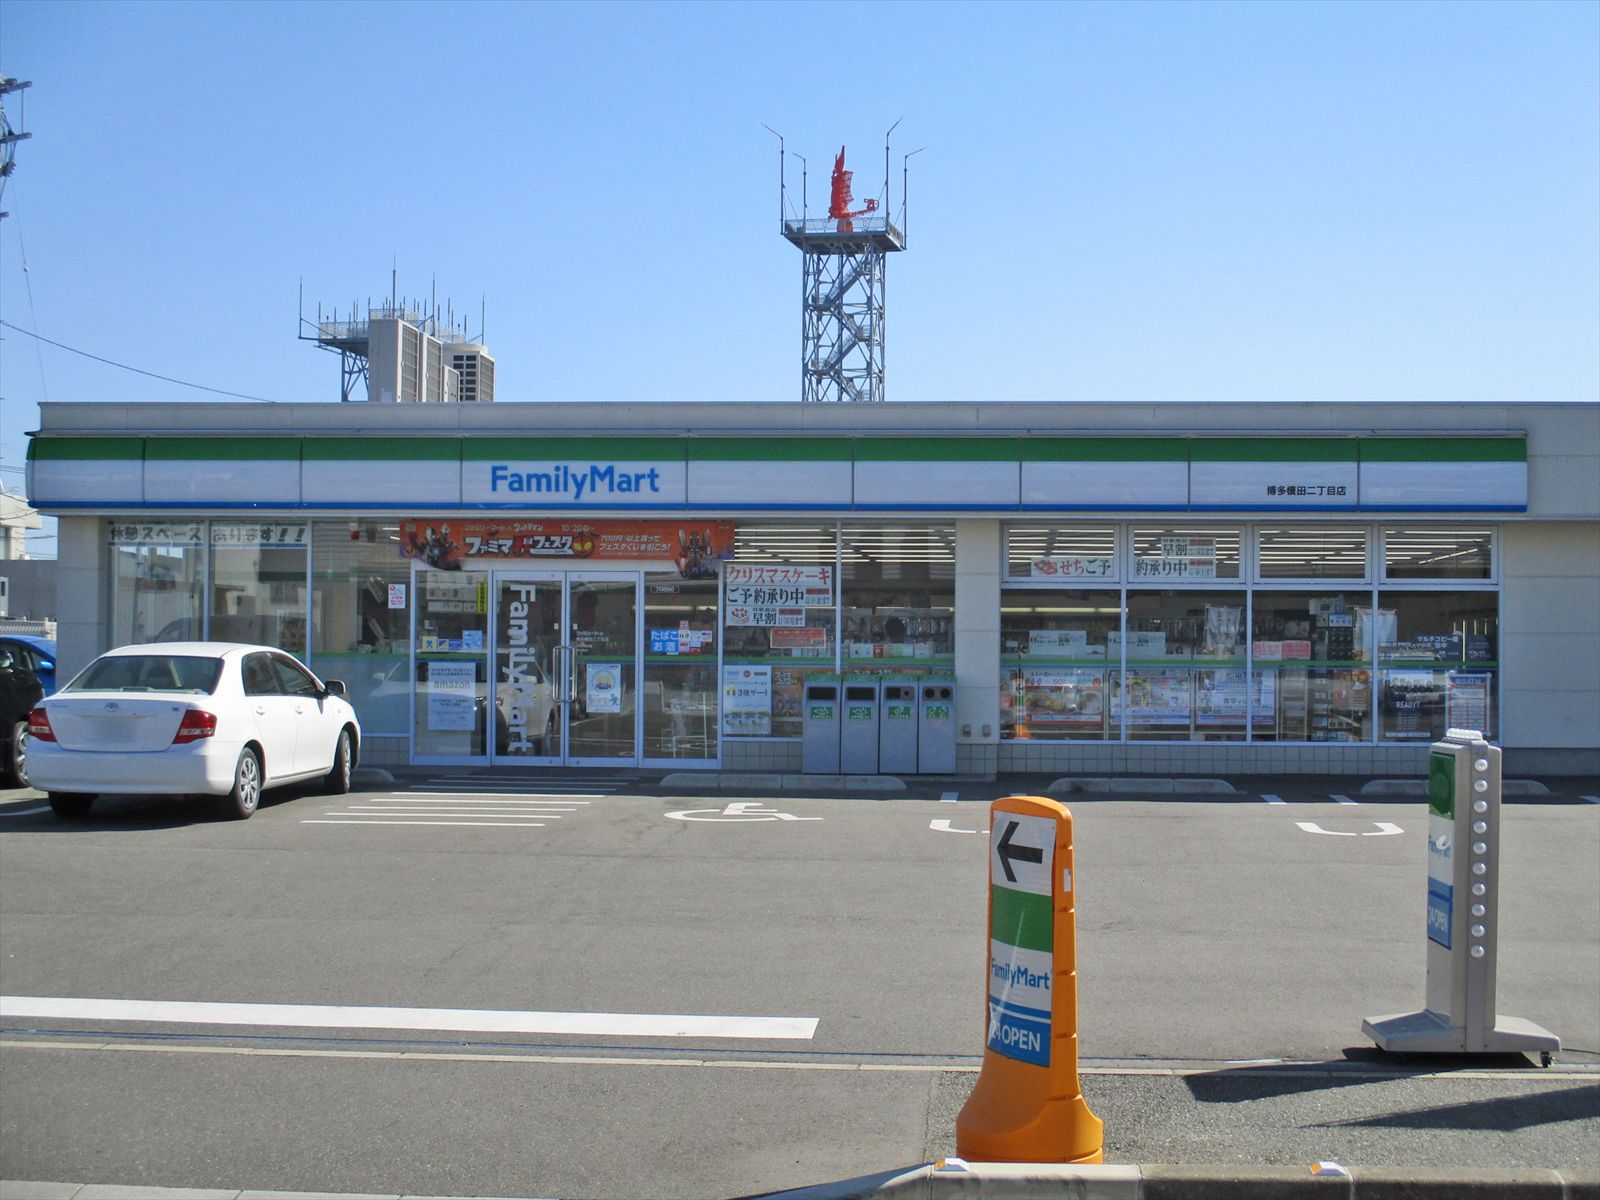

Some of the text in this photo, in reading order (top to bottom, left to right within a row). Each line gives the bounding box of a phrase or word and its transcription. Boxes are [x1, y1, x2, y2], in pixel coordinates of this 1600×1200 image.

[491, 465, 660, 500] FamilyMart
[110, 526, 201, 542] 休憩スペース
[728, 566, 831, 585] クリスマスケーキ
[1136, 558, 1188, 576] 約承り中
[727, 587, 804, 605] ご予約承り中
[752, 612, 777, 625] 早割
[651, 630, 679, 641] たばこ
[502, 584, 537, 753] FamilyMart
[433, 680, 471, 689] amazon
[991, 957, 1050, 990] FamilyMart
[1002, 1024, 1041, 1052] OPEN
